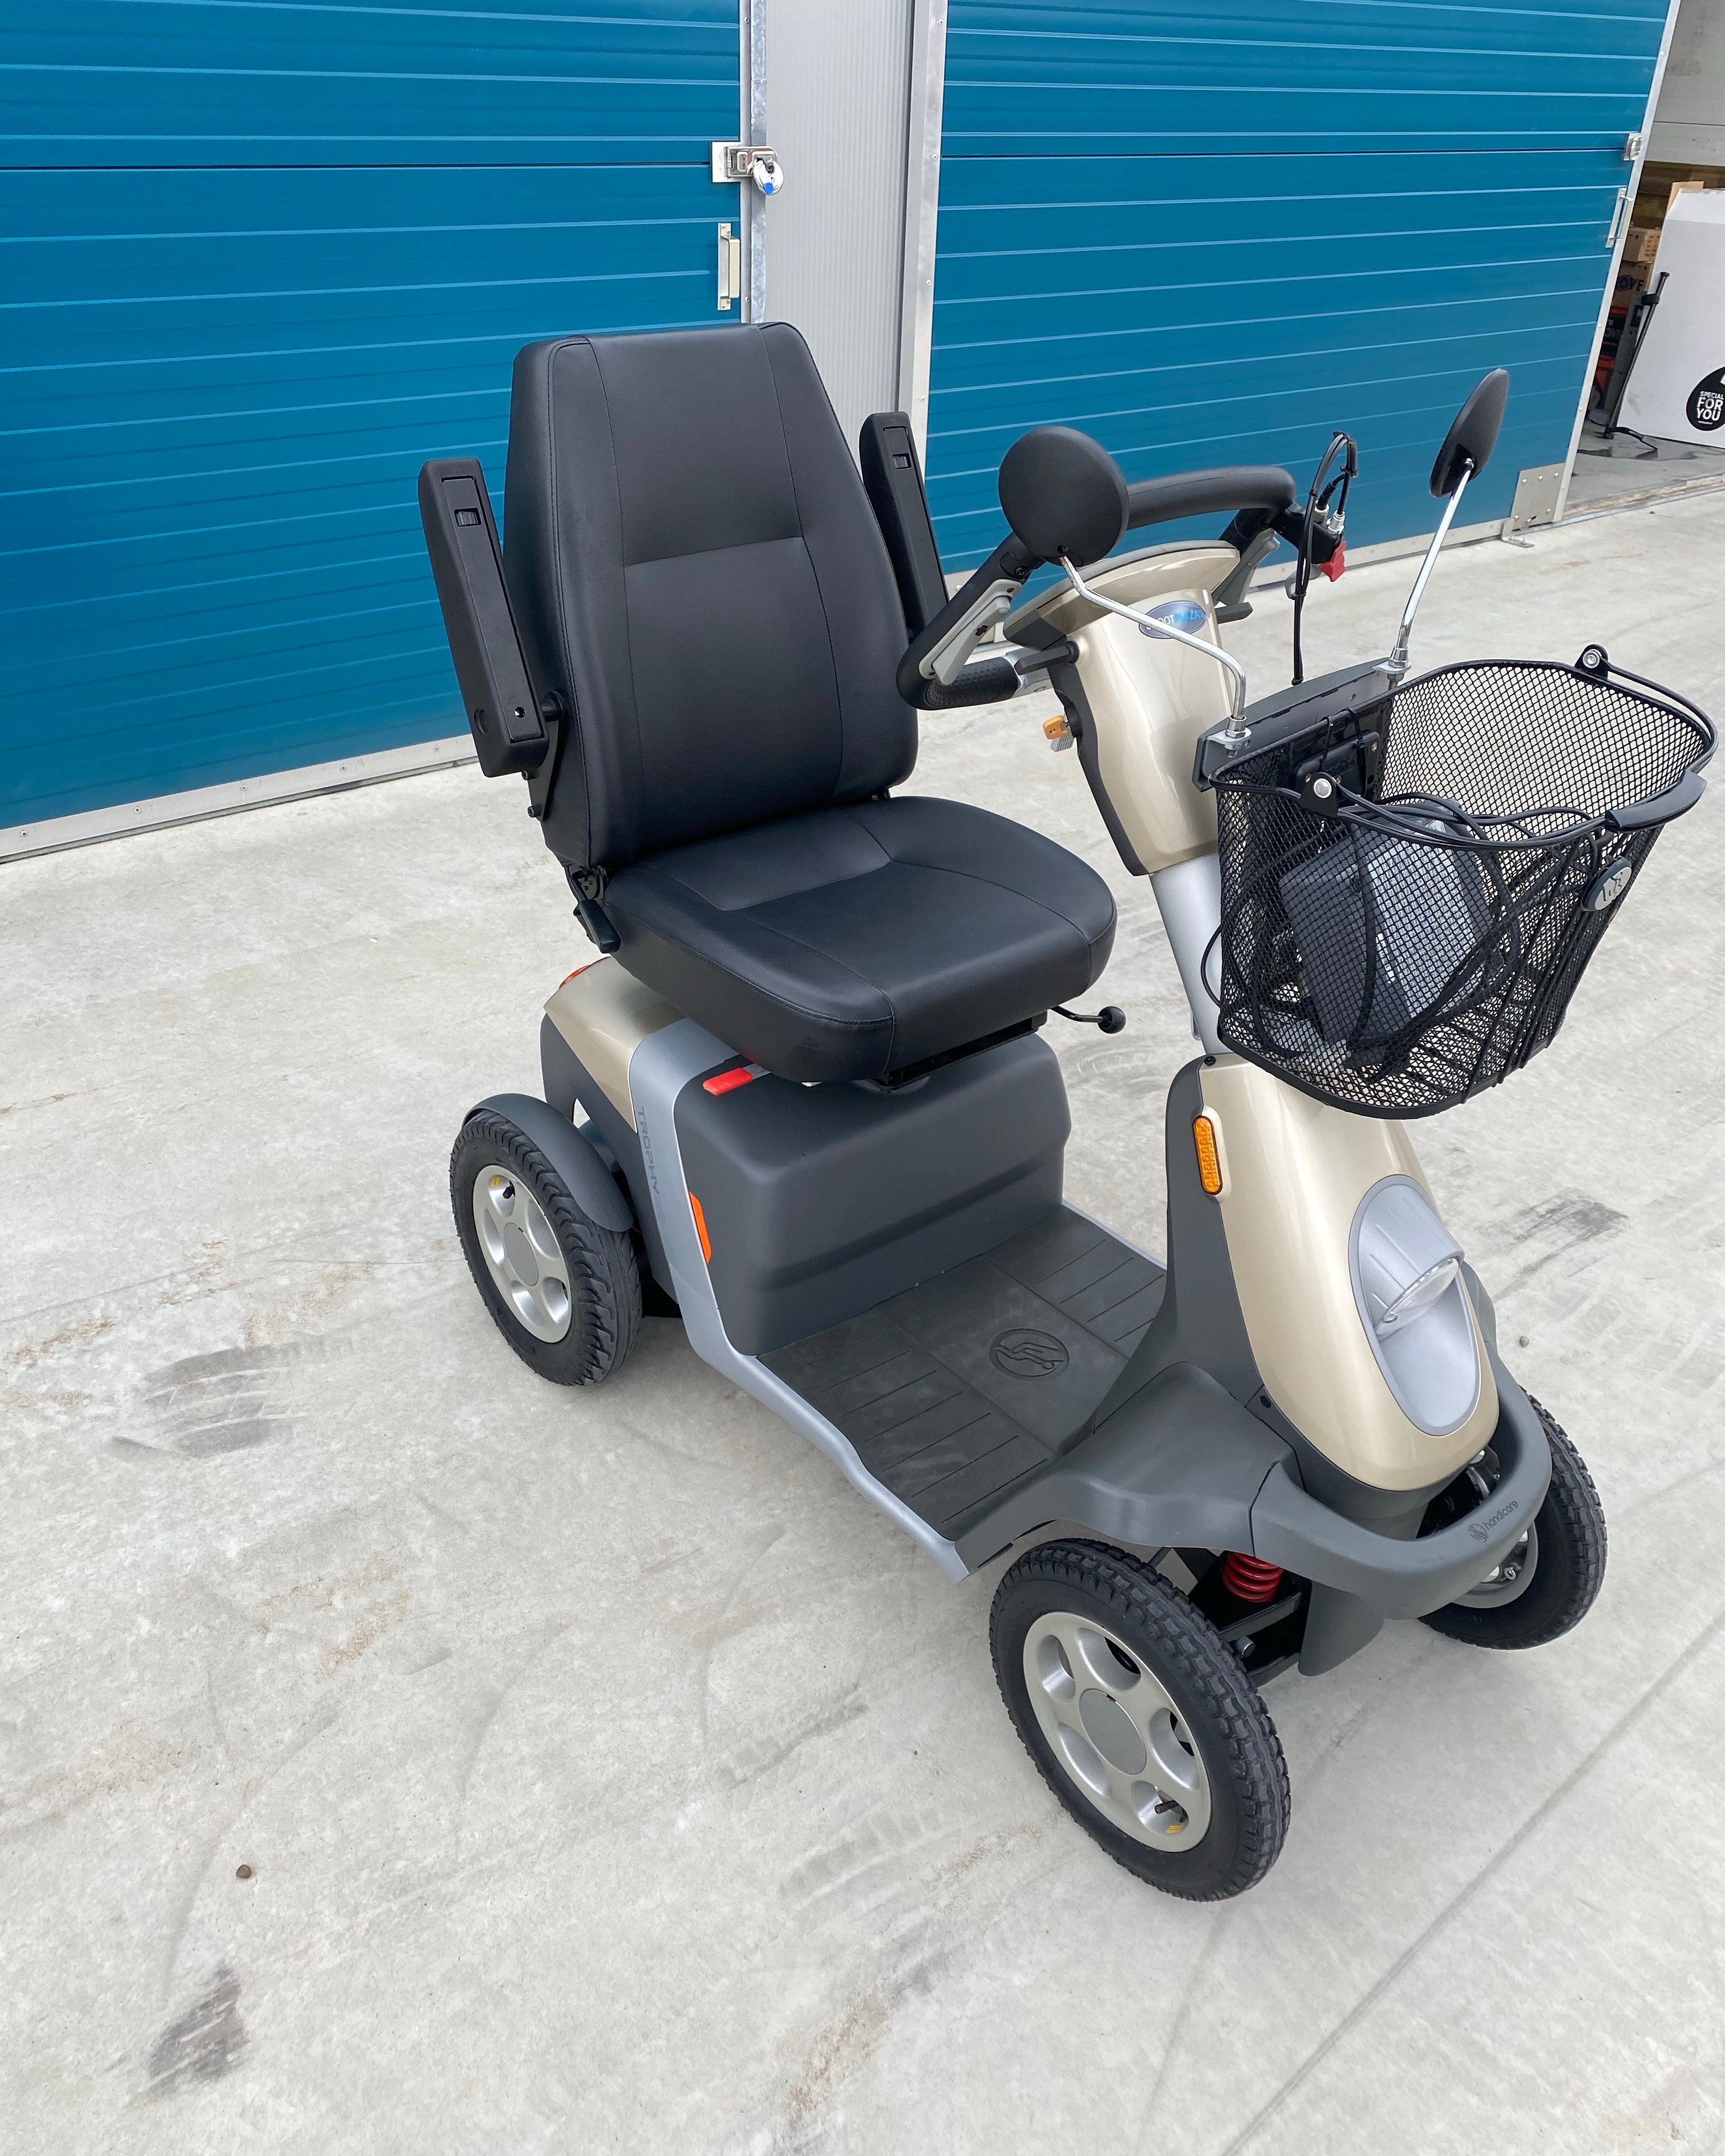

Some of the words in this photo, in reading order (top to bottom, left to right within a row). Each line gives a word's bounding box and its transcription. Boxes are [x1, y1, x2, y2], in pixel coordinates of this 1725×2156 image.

[1700, 391, 1724, 400] SPECIAL
[1697, 396, 1723, 411] FOR
[1696, 407, 1721, 421] YOU
[638, 1106, 660, 1195] TROPHY
[1483, 1501, 1519, 1530] handicare
